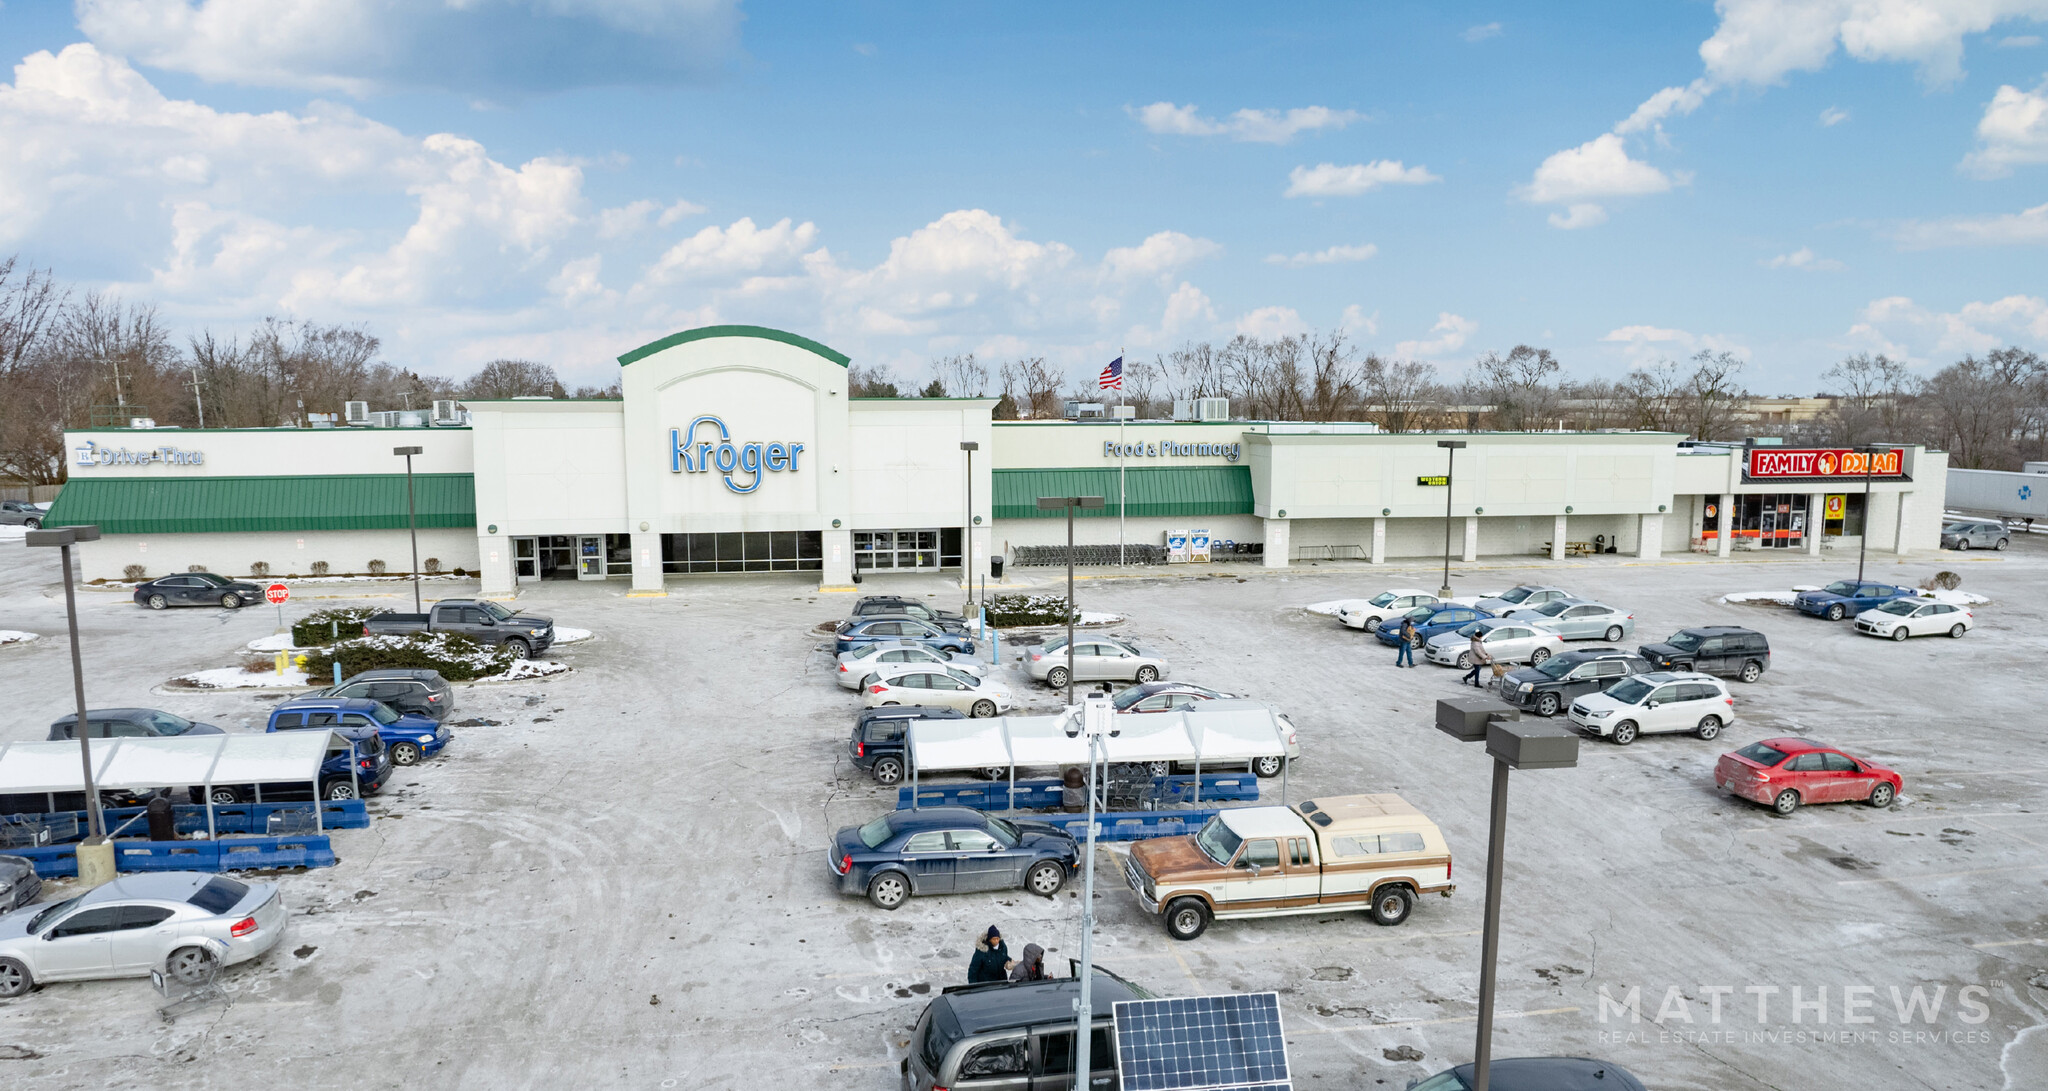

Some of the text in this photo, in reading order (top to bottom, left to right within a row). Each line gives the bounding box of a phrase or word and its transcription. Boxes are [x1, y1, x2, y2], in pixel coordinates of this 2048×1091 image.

[100, 447, 202, 465] Drive-Thru
[670, 415, 804, 493] Kroger
[1104, 440, 1241, 462] Food & Pharmacy
[1757, 453, 1817, 474] FAMILY
[267, 589, 288, 599] STOP
